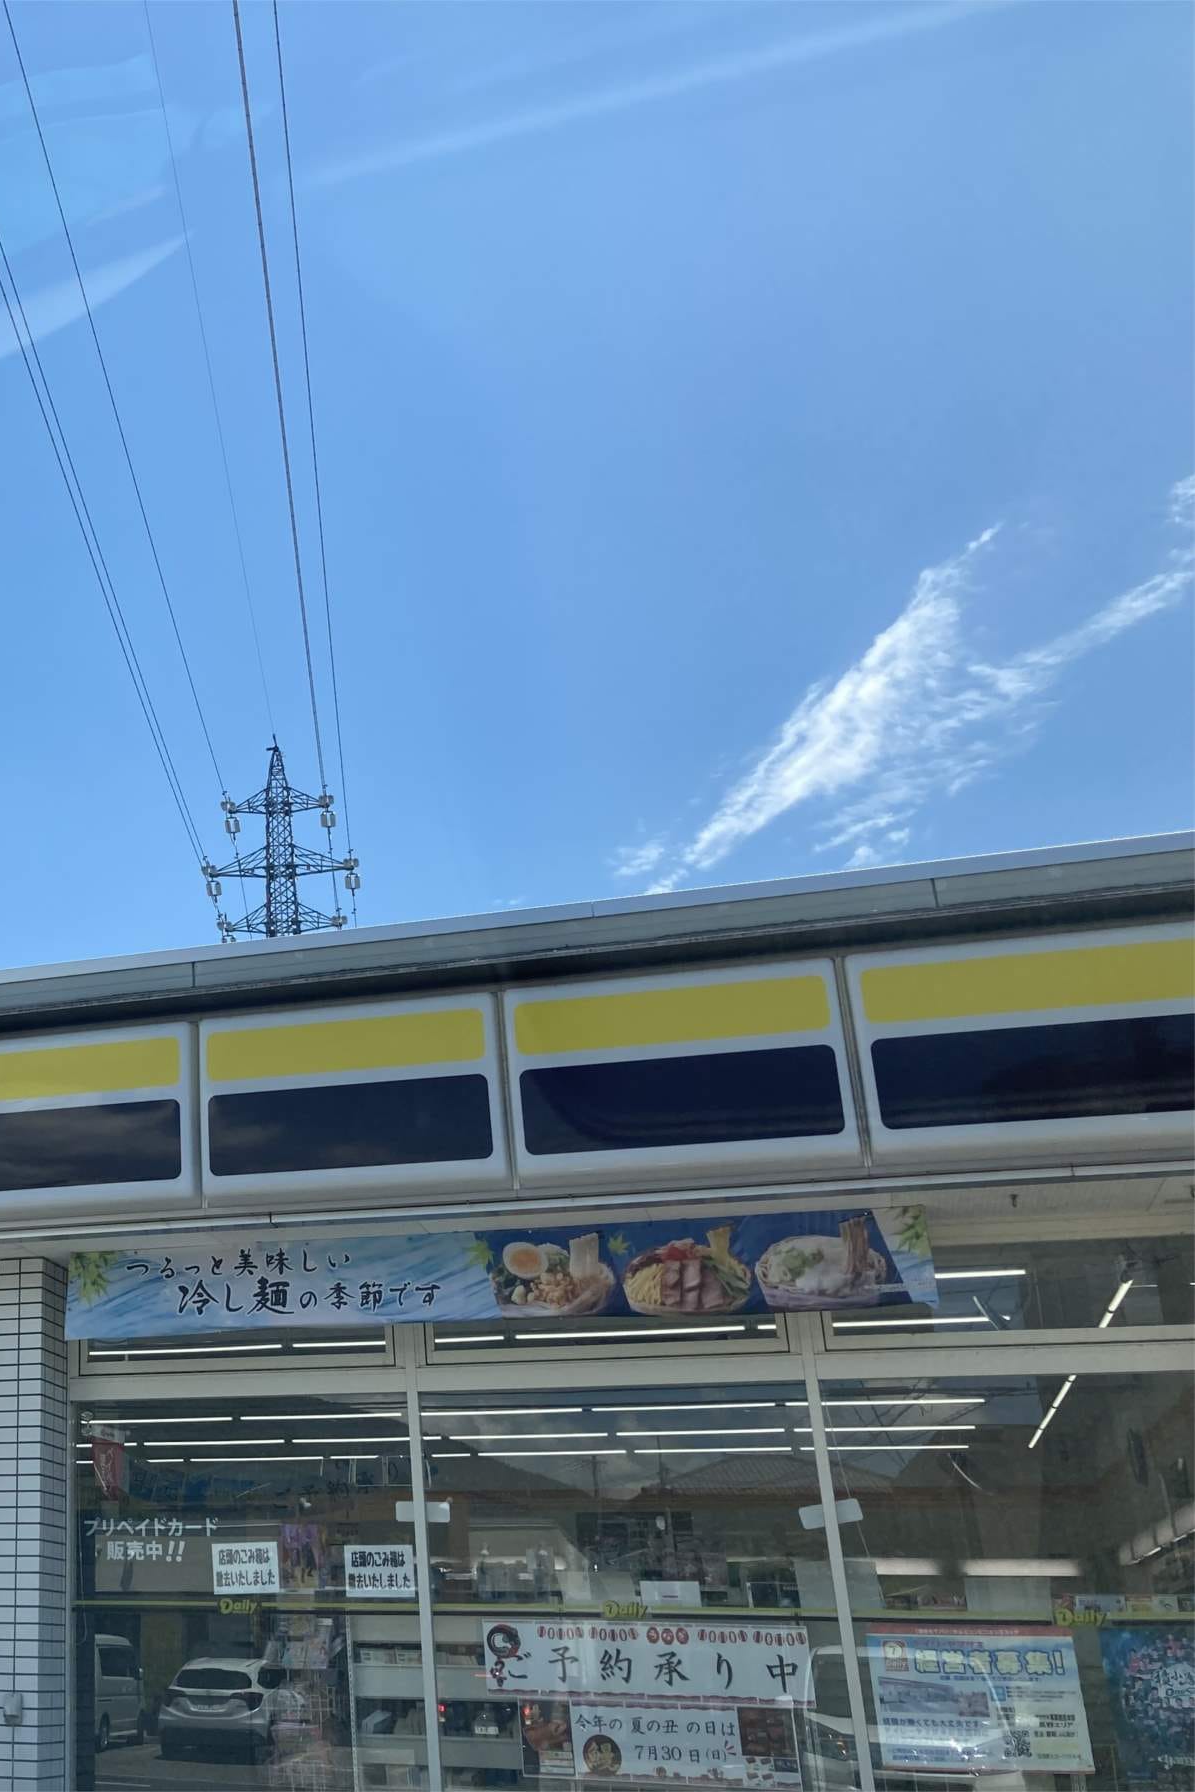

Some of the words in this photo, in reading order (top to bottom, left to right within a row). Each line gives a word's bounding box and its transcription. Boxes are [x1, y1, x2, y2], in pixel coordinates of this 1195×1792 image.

[126, 1248, 350, 1279] つるっと美味しい
[178, 1275, 441, 1316] 冷し麺の季節です
[83, 1517, 220, 1538] プリペイドカード
[106, 1540, 186, 1562] 販売中!!
[218, 1547, 271, 1566] 店頭のごみ箱は
[351, 1550, 406, 1568] 店頭のごみ箱は
[218, 1597, 258, 1615] Daily
[604, 1600, 649, 1618] Daily
[1055, 1608, 1106, 1627] Daily
[508, 1646, 799, 1693] ご予約承り中
[575, 1713, 736, 1736] 今年の夏の丑の日は
[634, 1744, 727, 1764] 7月30日(日)
